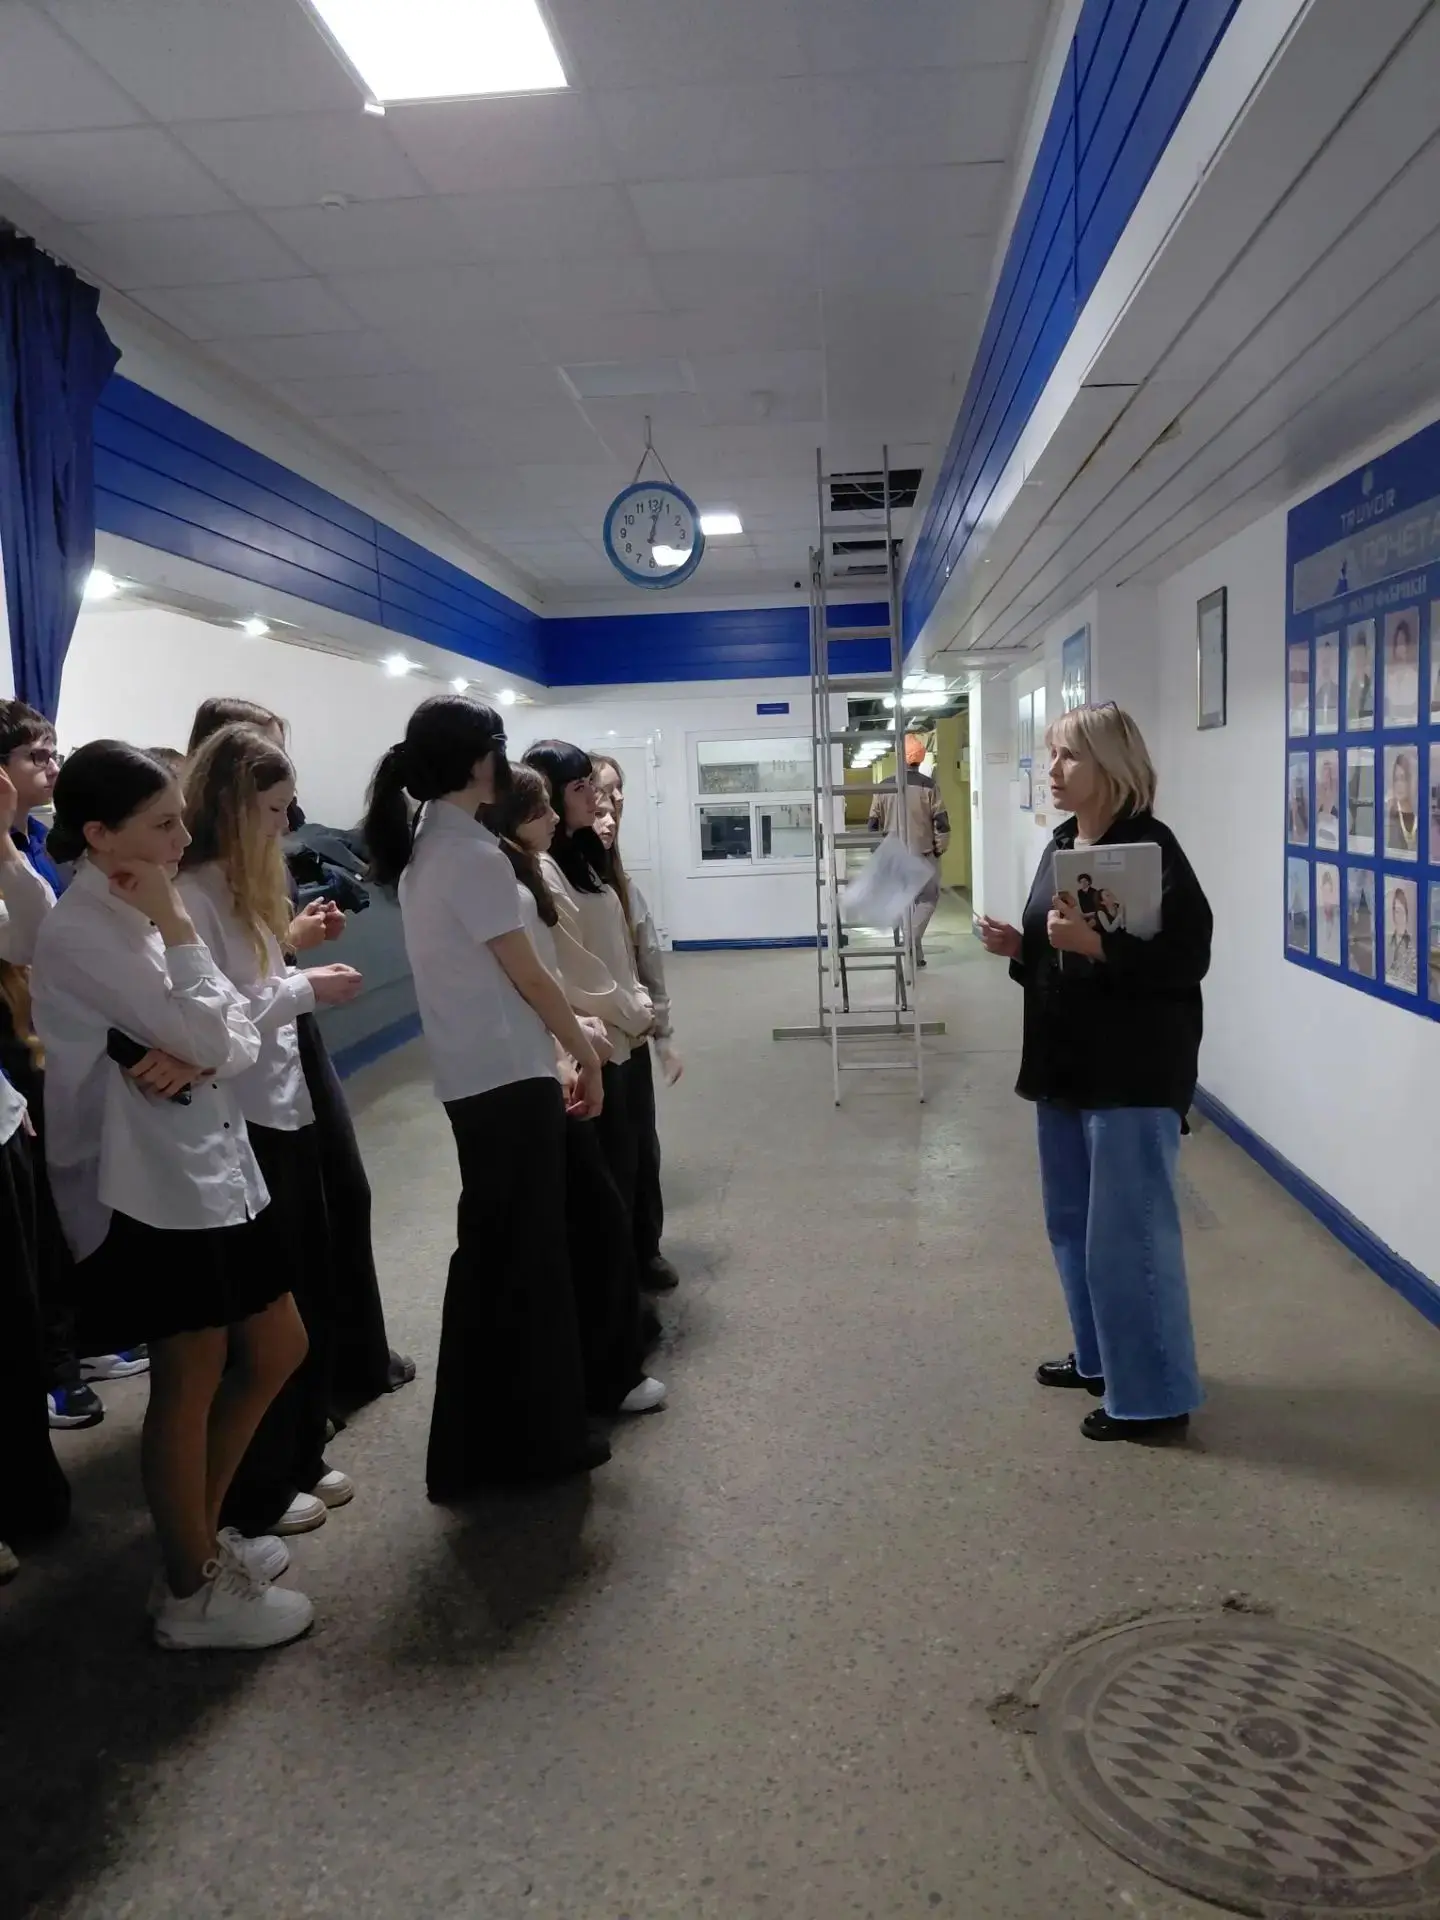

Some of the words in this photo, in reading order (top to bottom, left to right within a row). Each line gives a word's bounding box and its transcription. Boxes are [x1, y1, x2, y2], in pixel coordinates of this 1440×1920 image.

[636, 503, 644, 514] 11
[624, 514, 635, 526] 10
[674, 515, 681, 526] 2
[620, 528, 627, 539] 9
[680, 529, 686, 539] 3
[625, 543, 632, 553] 8
[636, 553, 642, 564] 7
